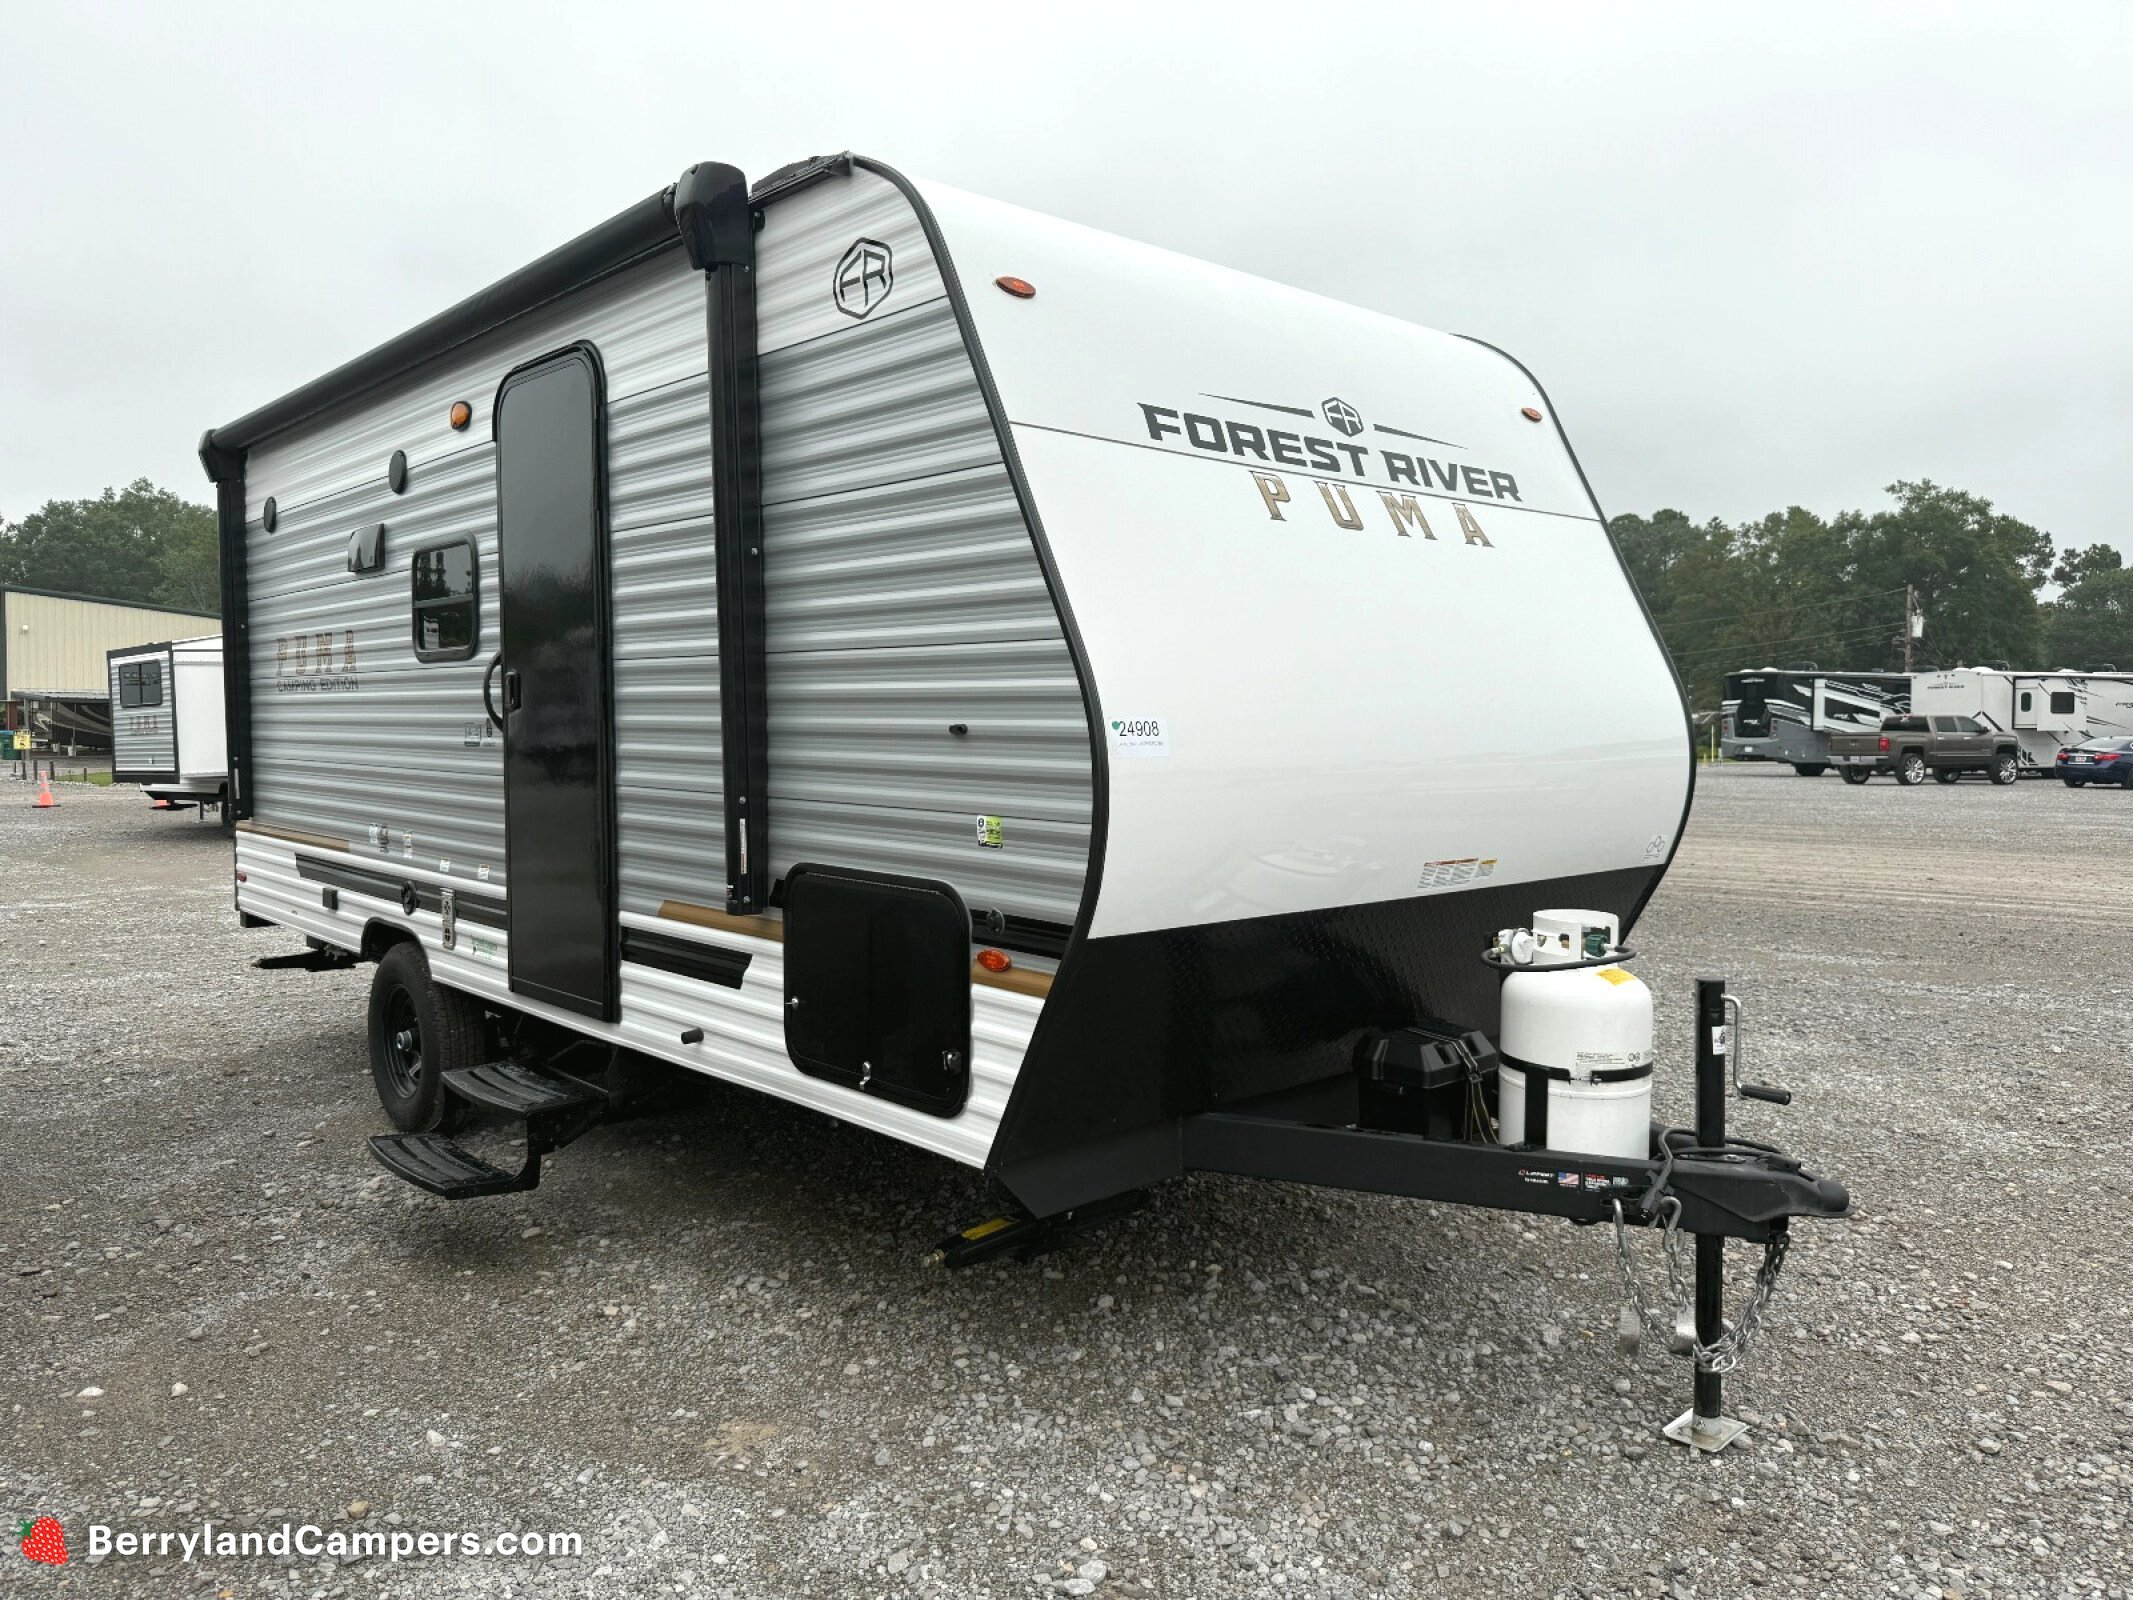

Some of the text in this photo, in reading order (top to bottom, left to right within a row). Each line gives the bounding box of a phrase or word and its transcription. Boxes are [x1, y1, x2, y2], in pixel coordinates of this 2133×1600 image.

[1137, 402, 1523, 502] FOREST RIVER
[1250, 470, 1495, 548] PUMA
[276, 630, 357, 676] PUMA
[277, 676, 359, 692] CAMPING EDITION
[1119, 720, 1160, 737] 24908
